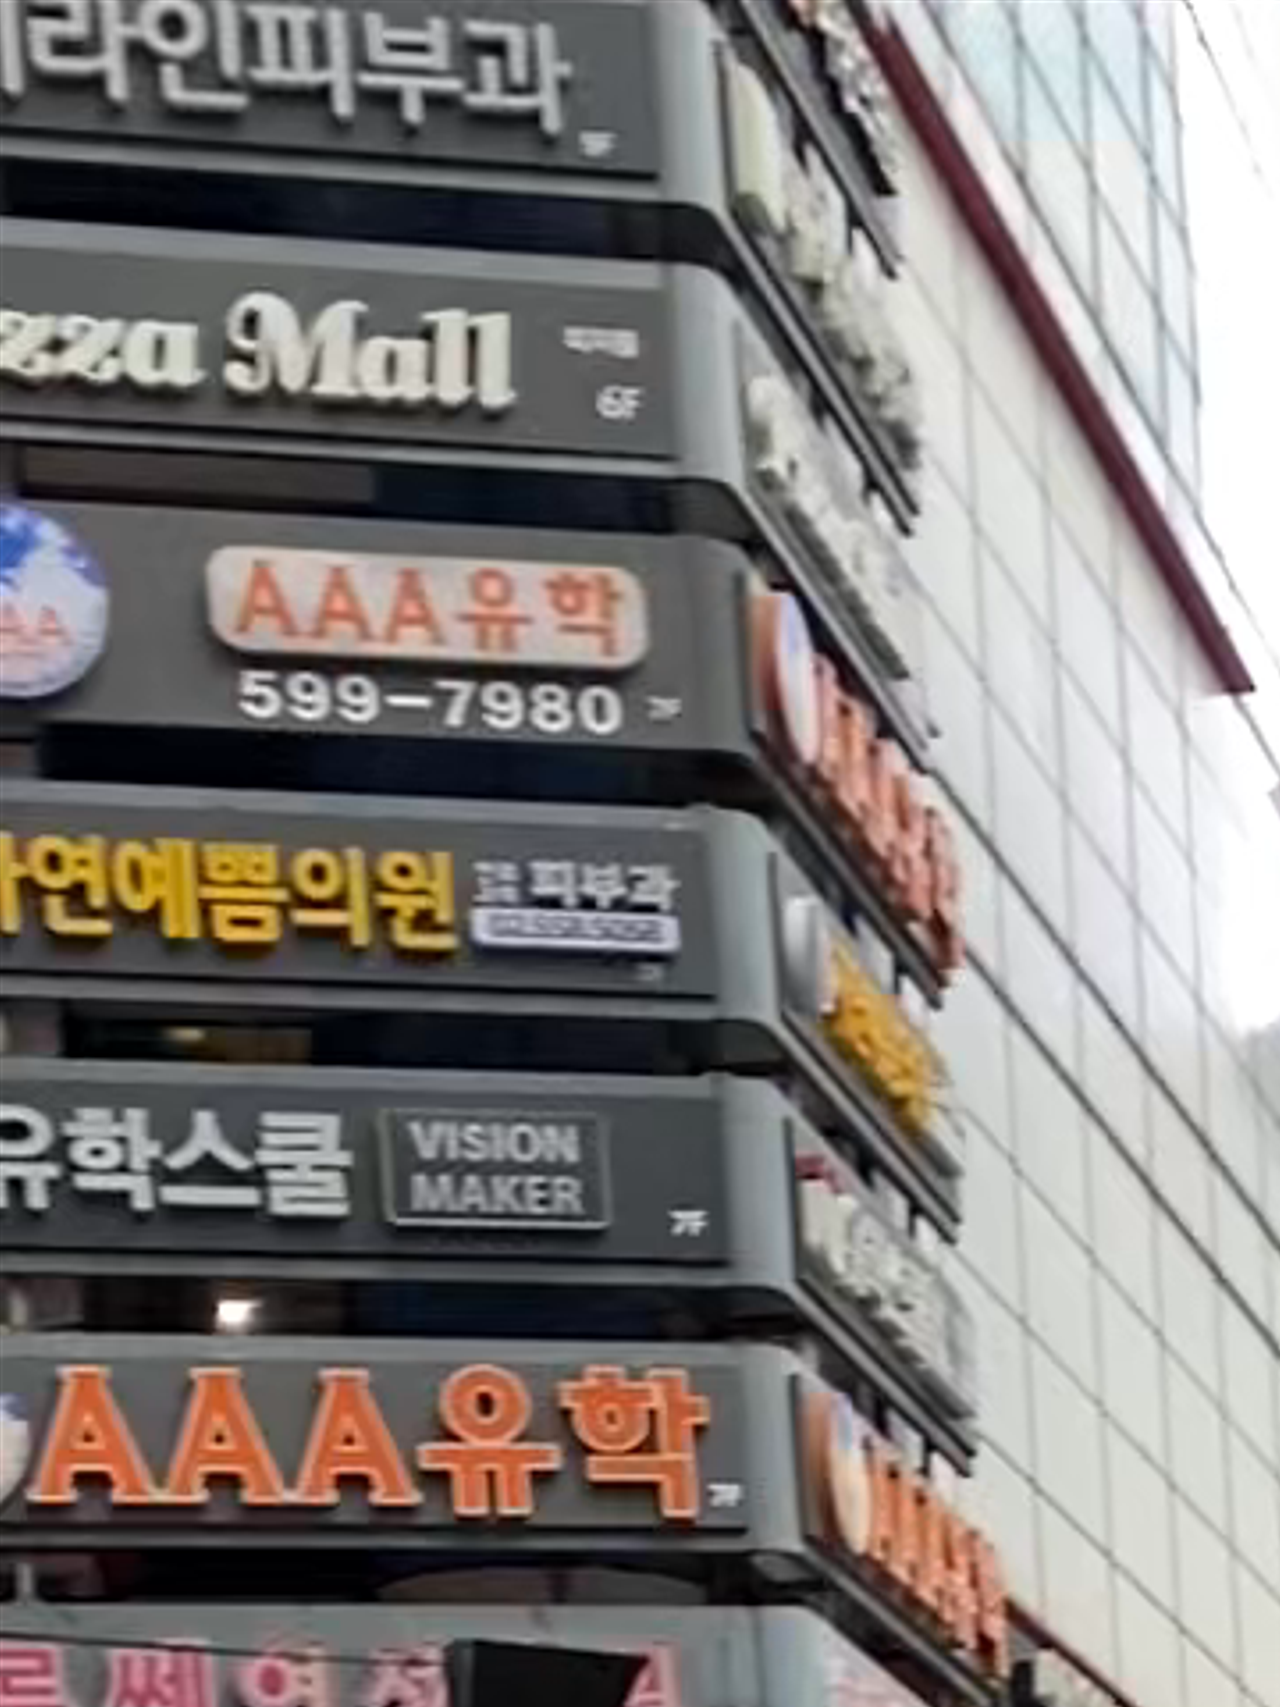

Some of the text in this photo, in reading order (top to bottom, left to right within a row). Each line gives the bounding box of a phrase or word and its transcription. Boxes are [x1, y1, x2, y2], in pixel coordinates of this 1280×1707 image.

[0, 0, 572, 135] 라인피부과
[223, 293, 518, 410] Mall
[235, 558, 623, 656] AAA유학
[238, 670, 624, 734] 599-7980
[0, 1104, 354, 1218] 유학스쿨
[409, 1120, 580, 1165] VISION
[410, 1174, 584, 1217] MAKER
[27, 1364, 710, 1521] AAA유학
